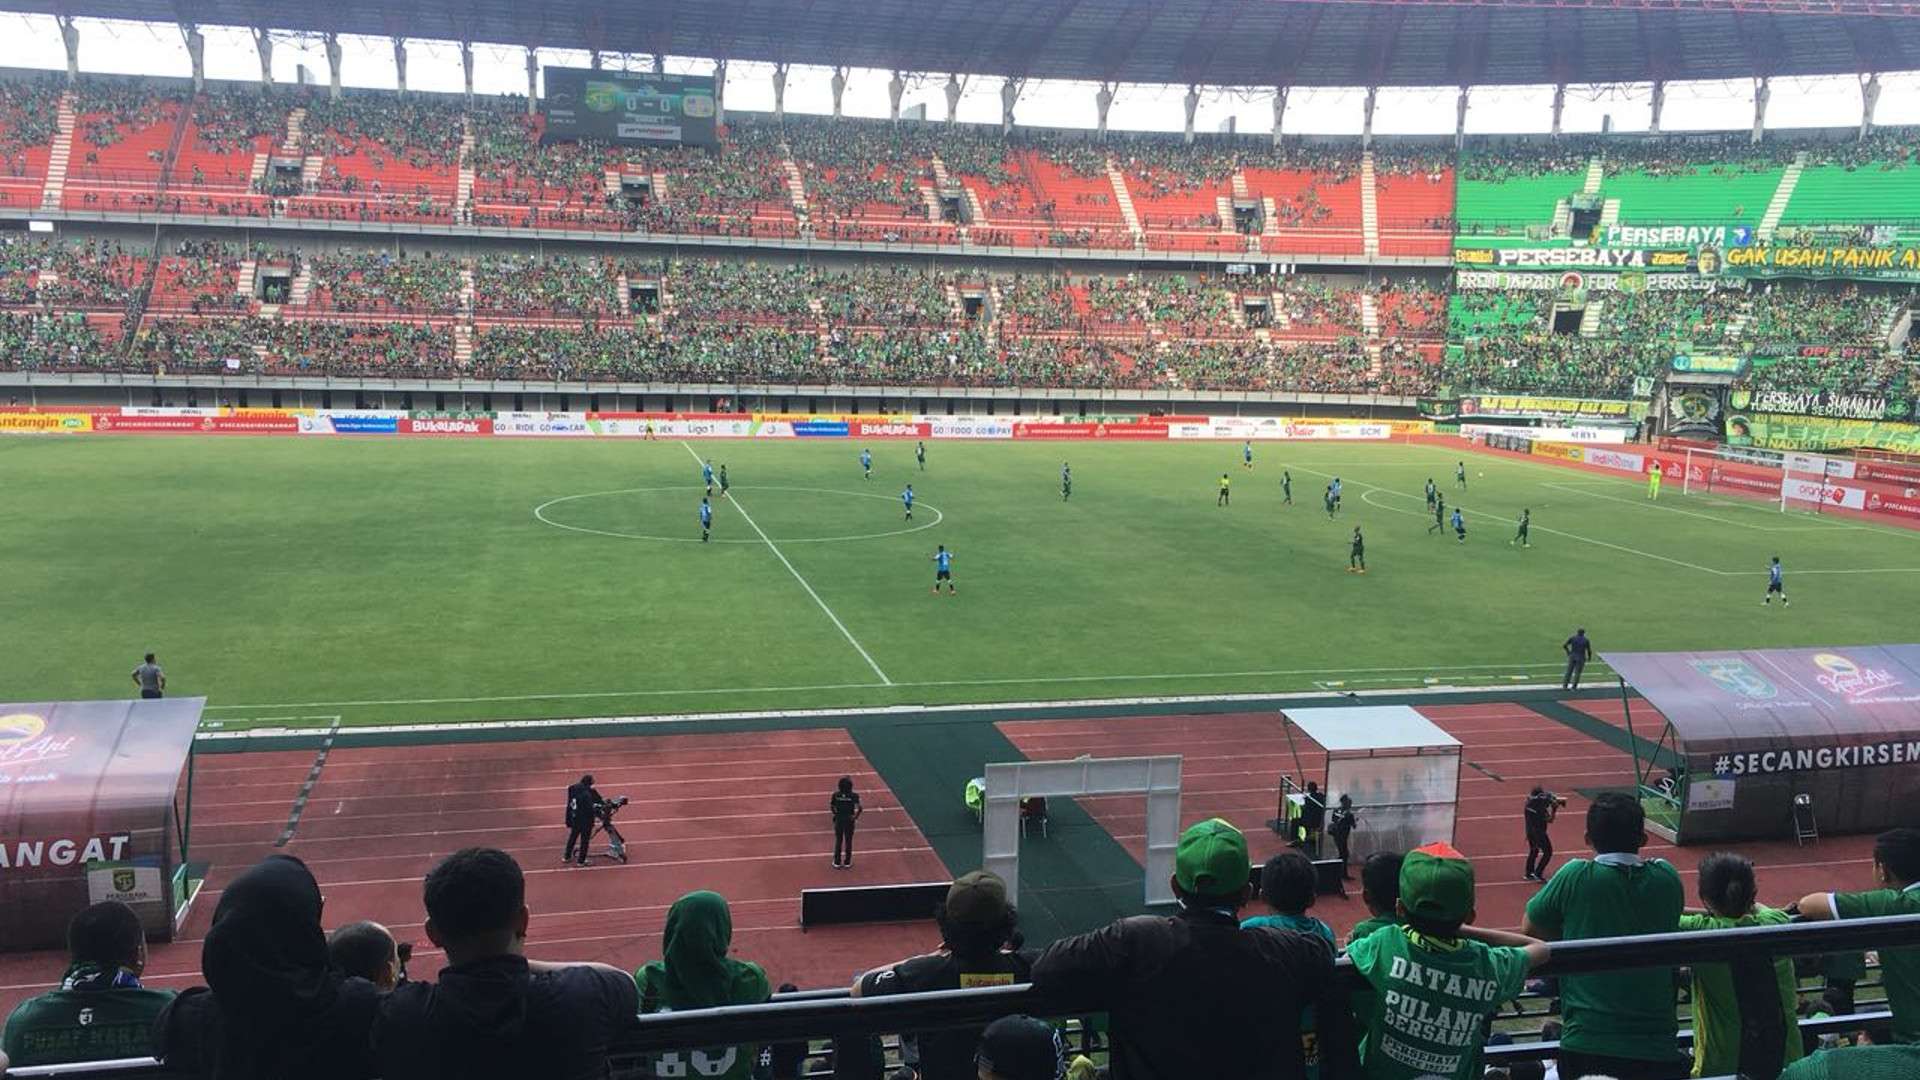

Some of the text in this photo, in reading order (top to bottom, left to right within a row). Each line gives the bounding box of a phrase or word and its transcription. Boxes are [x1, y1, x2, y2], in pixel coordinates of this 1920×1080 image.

[1608, 226, 1725, 246] PERSEBAYA
[1500, 249, 1645, 266] PERSEBAYA
[1727, 248, 1768, 265] GAK
[1775, 248, 1827, 267] USAH
[1832, 249, 1896, 268] PANIK
[1589, 273, 1617, 290] FOR
[516, 424, 534, 432] RIDE
[688, 424, 708, 434] Liga
[933, 426, 971, 434] GO FOOD
[996, 427, 1011, 435] PAY
[1755, 438, 1766, 448] DI
[1390, 955, 1497, 1001] DATANG
[1384, 1007, 1473, 1047] BERSAMA
